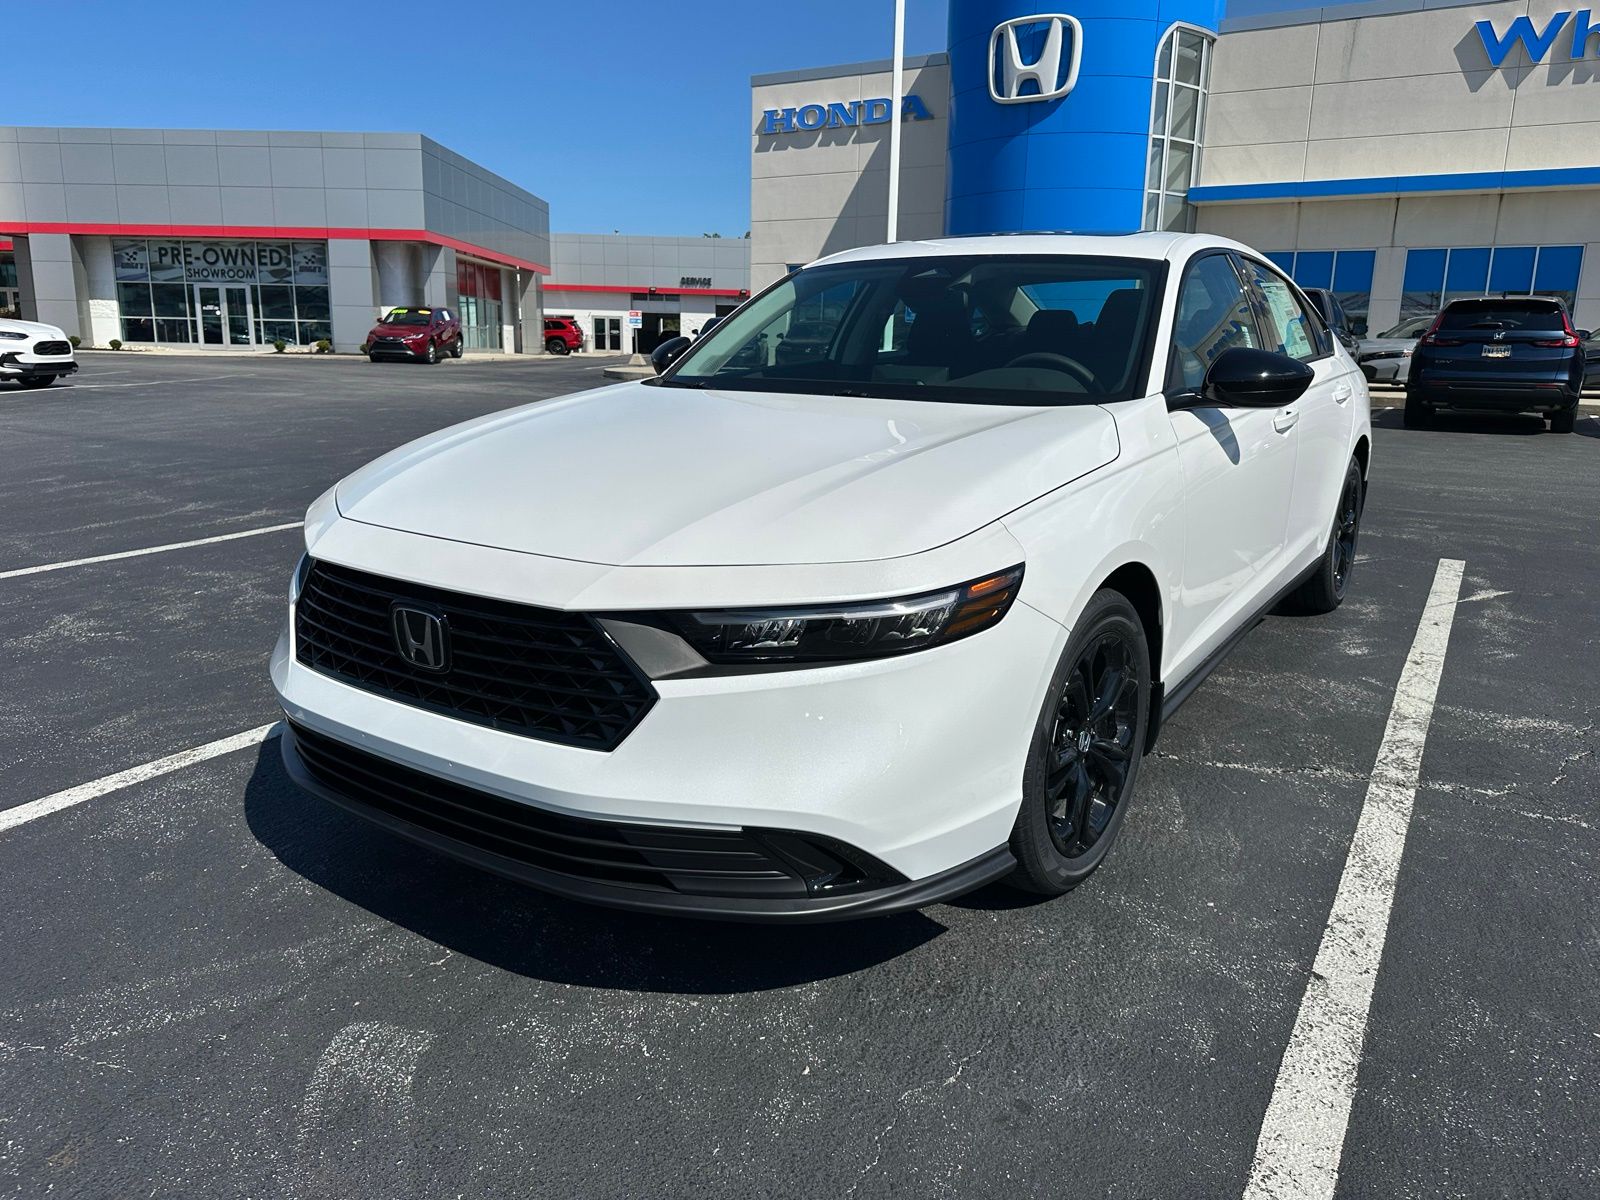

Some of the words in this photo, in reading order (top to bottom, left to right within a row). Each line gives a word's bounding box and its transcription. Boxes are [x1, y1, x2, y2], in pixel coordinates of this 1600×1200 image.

[762, 95, 934, 135] HONDA
[158, 246, 283, 267] PRE-OWNED
[187, 267, 256, 279] SHOWROOM
[680, 276, 712, 287] SERVICE
